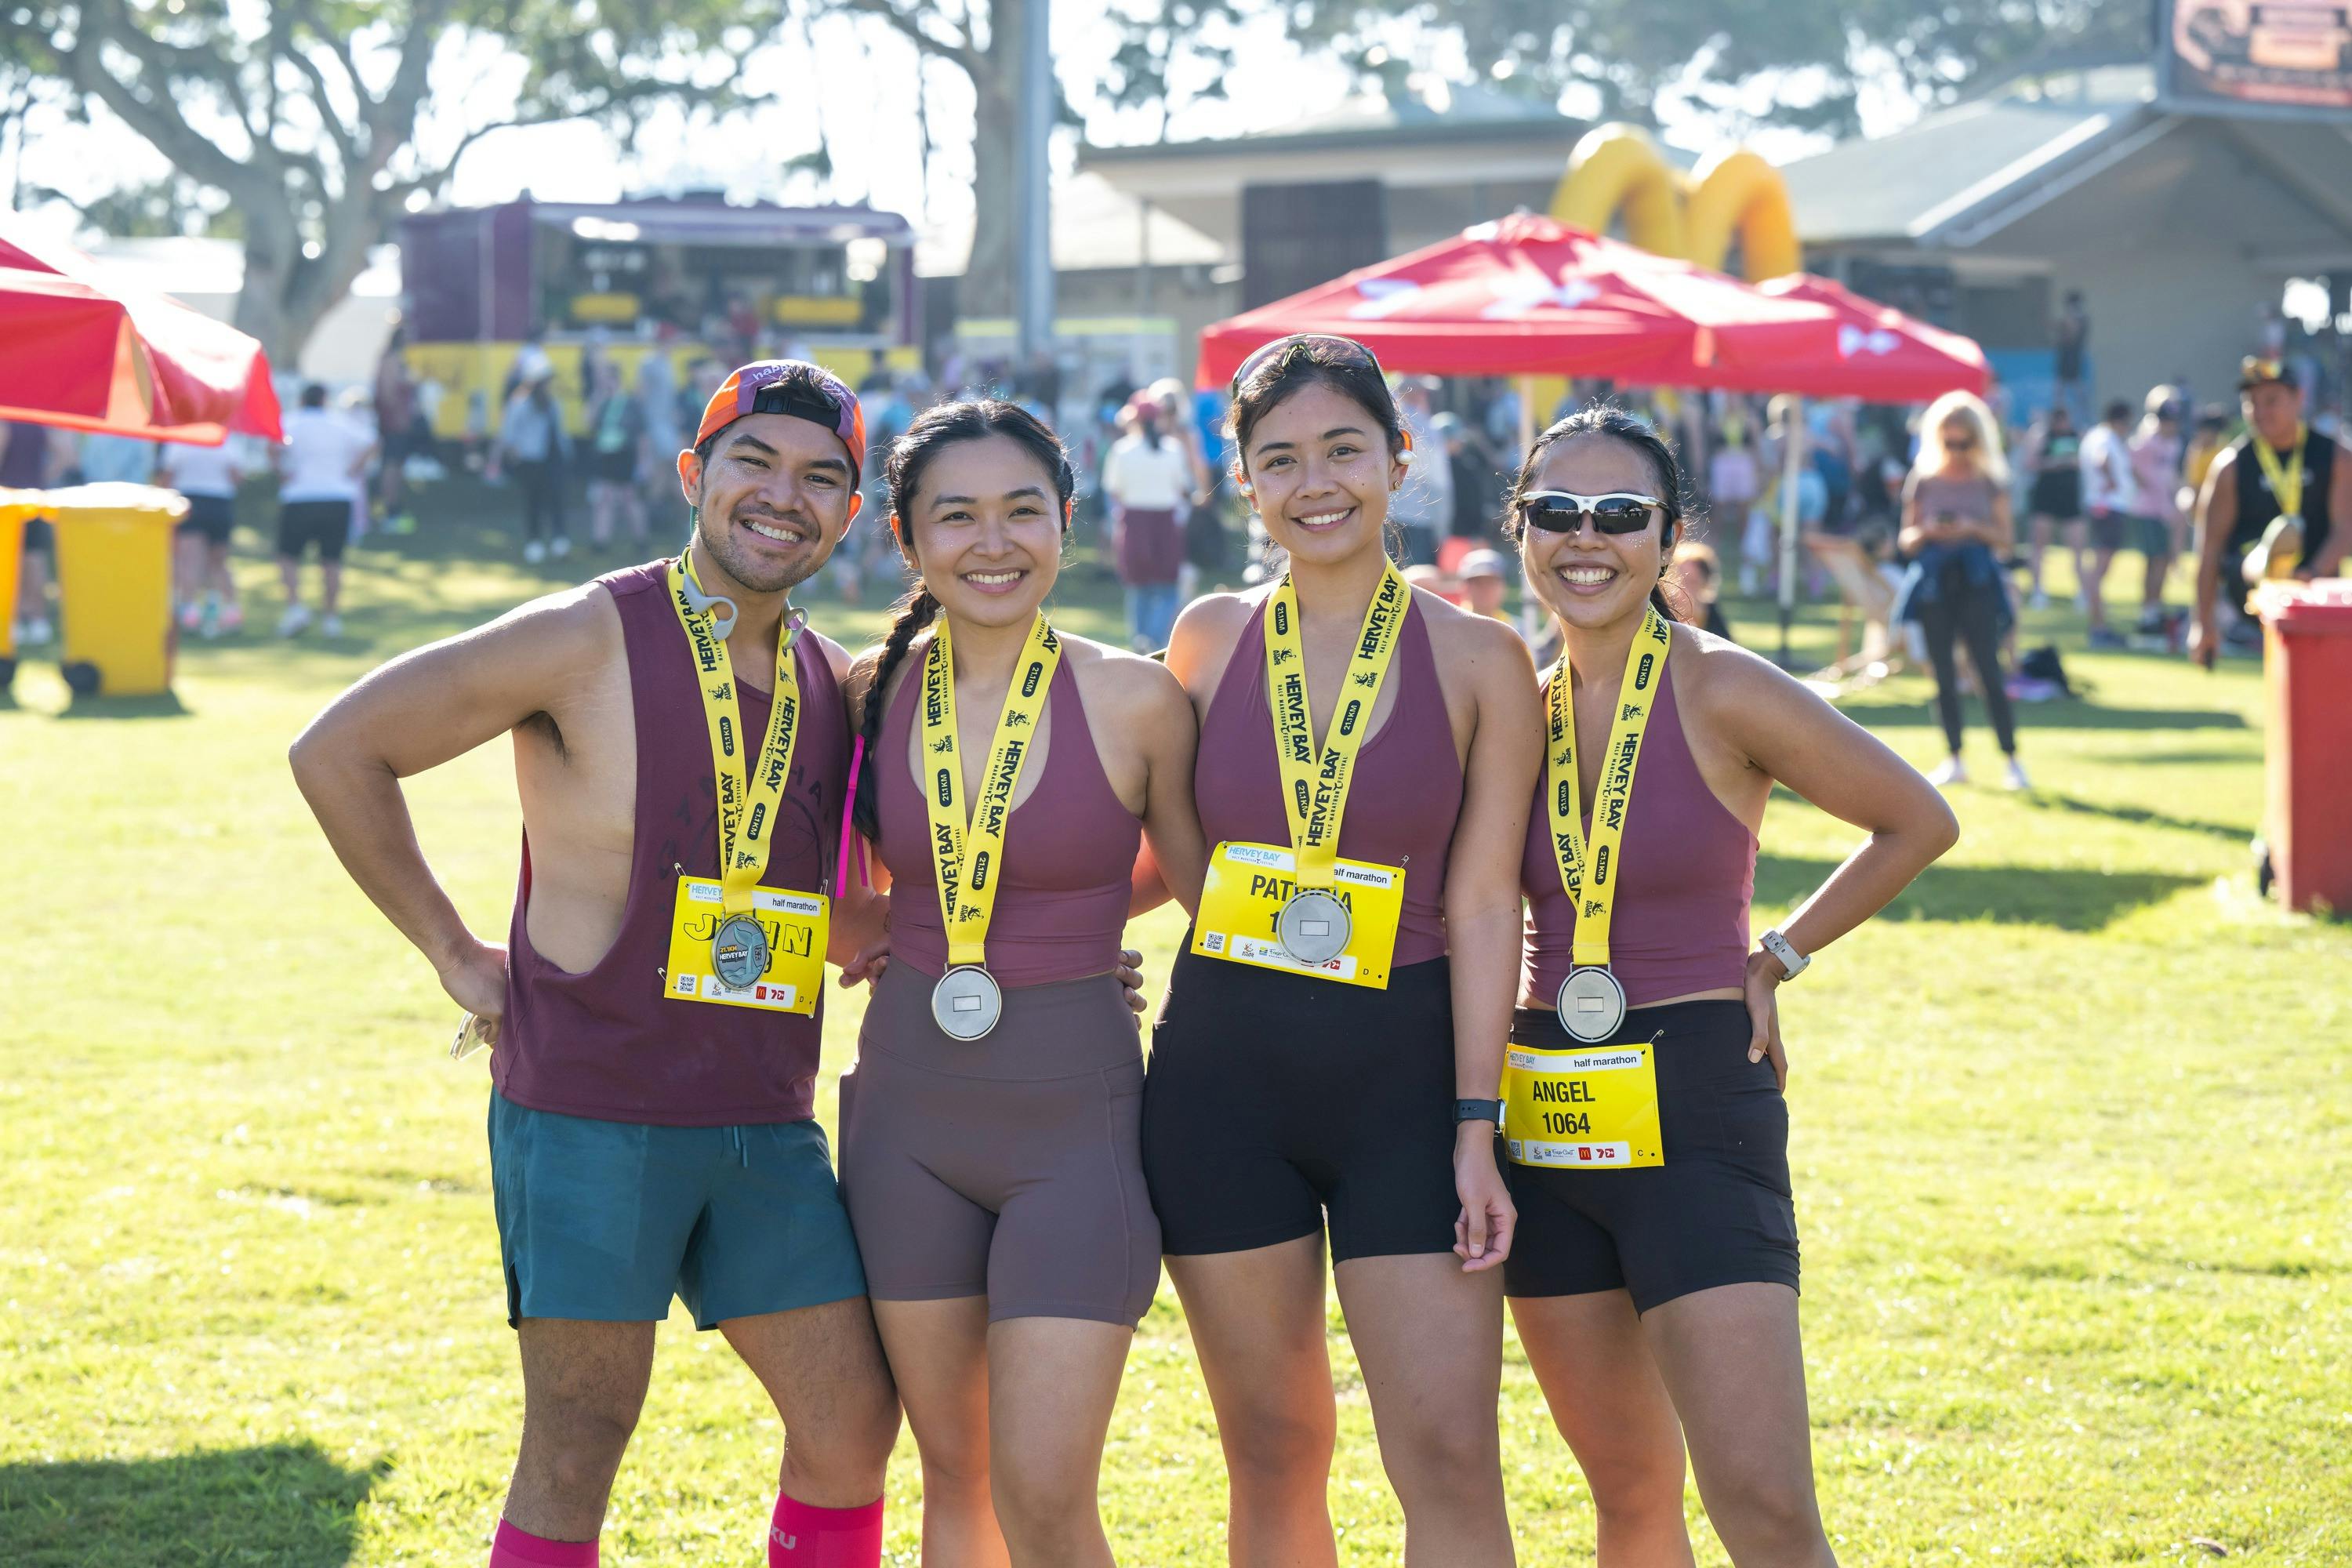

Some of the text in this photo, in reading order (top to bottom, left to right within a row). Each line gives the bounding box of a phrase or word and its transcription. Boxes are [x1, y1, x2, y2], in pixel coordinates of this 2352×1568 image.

[1277, 606, 1286, 632] 21.1KM
[1359, 573, 1399, 659] HERVEY BAY
[1385, 612, 1399, 638] MARATHON
[685, 617, 717, 673] HERVEY
[1653, 619, 1667, 645] BAY
[927, 637, 942, 728] HERVEY BAY
[1025, 667, 1040, 692] 21.1KM
[1639, 659, 1650, 685] 21.1KM
[1285, 673, 1311, 764] HERVEY BAY
[1343, 704, 1358, 730] 21.1KM
[1551, 684, 1563, 742] HERVEY
[723, 722, 733, 751] 21.1KM
[776, 695, 796, 760] HERVEY
[766, 759, 786, 793] BAY
[987, 764, 999, 793] MARATHON
[1606, 759, 1617, 787] MARATHON
[1606, 733, 1639, 831] HERVEY BAY
[985, 740, 1024, 838] HERVEY BAY
[1298, 785, 1308, 814] 21.1KM
[1305, 747, 1341, 848] HERVEY BAY
[1329, 790, 1340, 821] MARATHON
[1338, 756, 1348, 783] FESTIVAL
[720, 771, 735, 872] ERVEY BAY
[750, 808, 763, 836] 21.1KM
[978, 801, 989, 827] FESTIVAL
[1599, 795, 1608, 822] FESTIVAL
[1229, 847, 1280, 862] HERVEY BAY
[1556, 833, 1575, 864] BAY
[935, 822, 959, 923] ERVEY BAY
[975, 857, 986, 885] 21.1KM
[1334, 868, 1388, 884] alf marathon
[1597, 851, 1607, 880] 21.1KM
[692, 885, 723, 896] HERVEY
[772, 898, 818, 912] half marathon
[684, 913, 813, 957] JHN
[720, 952, 738, 960] HERVEY
[1526, 1055, 1536, 1064] BAY
[1573, 1056, 1637, 1068] half marathon
[1533, 1080, 1595, 1103] ANGEL
[1542, 1112, 1591, 1134] 1064
